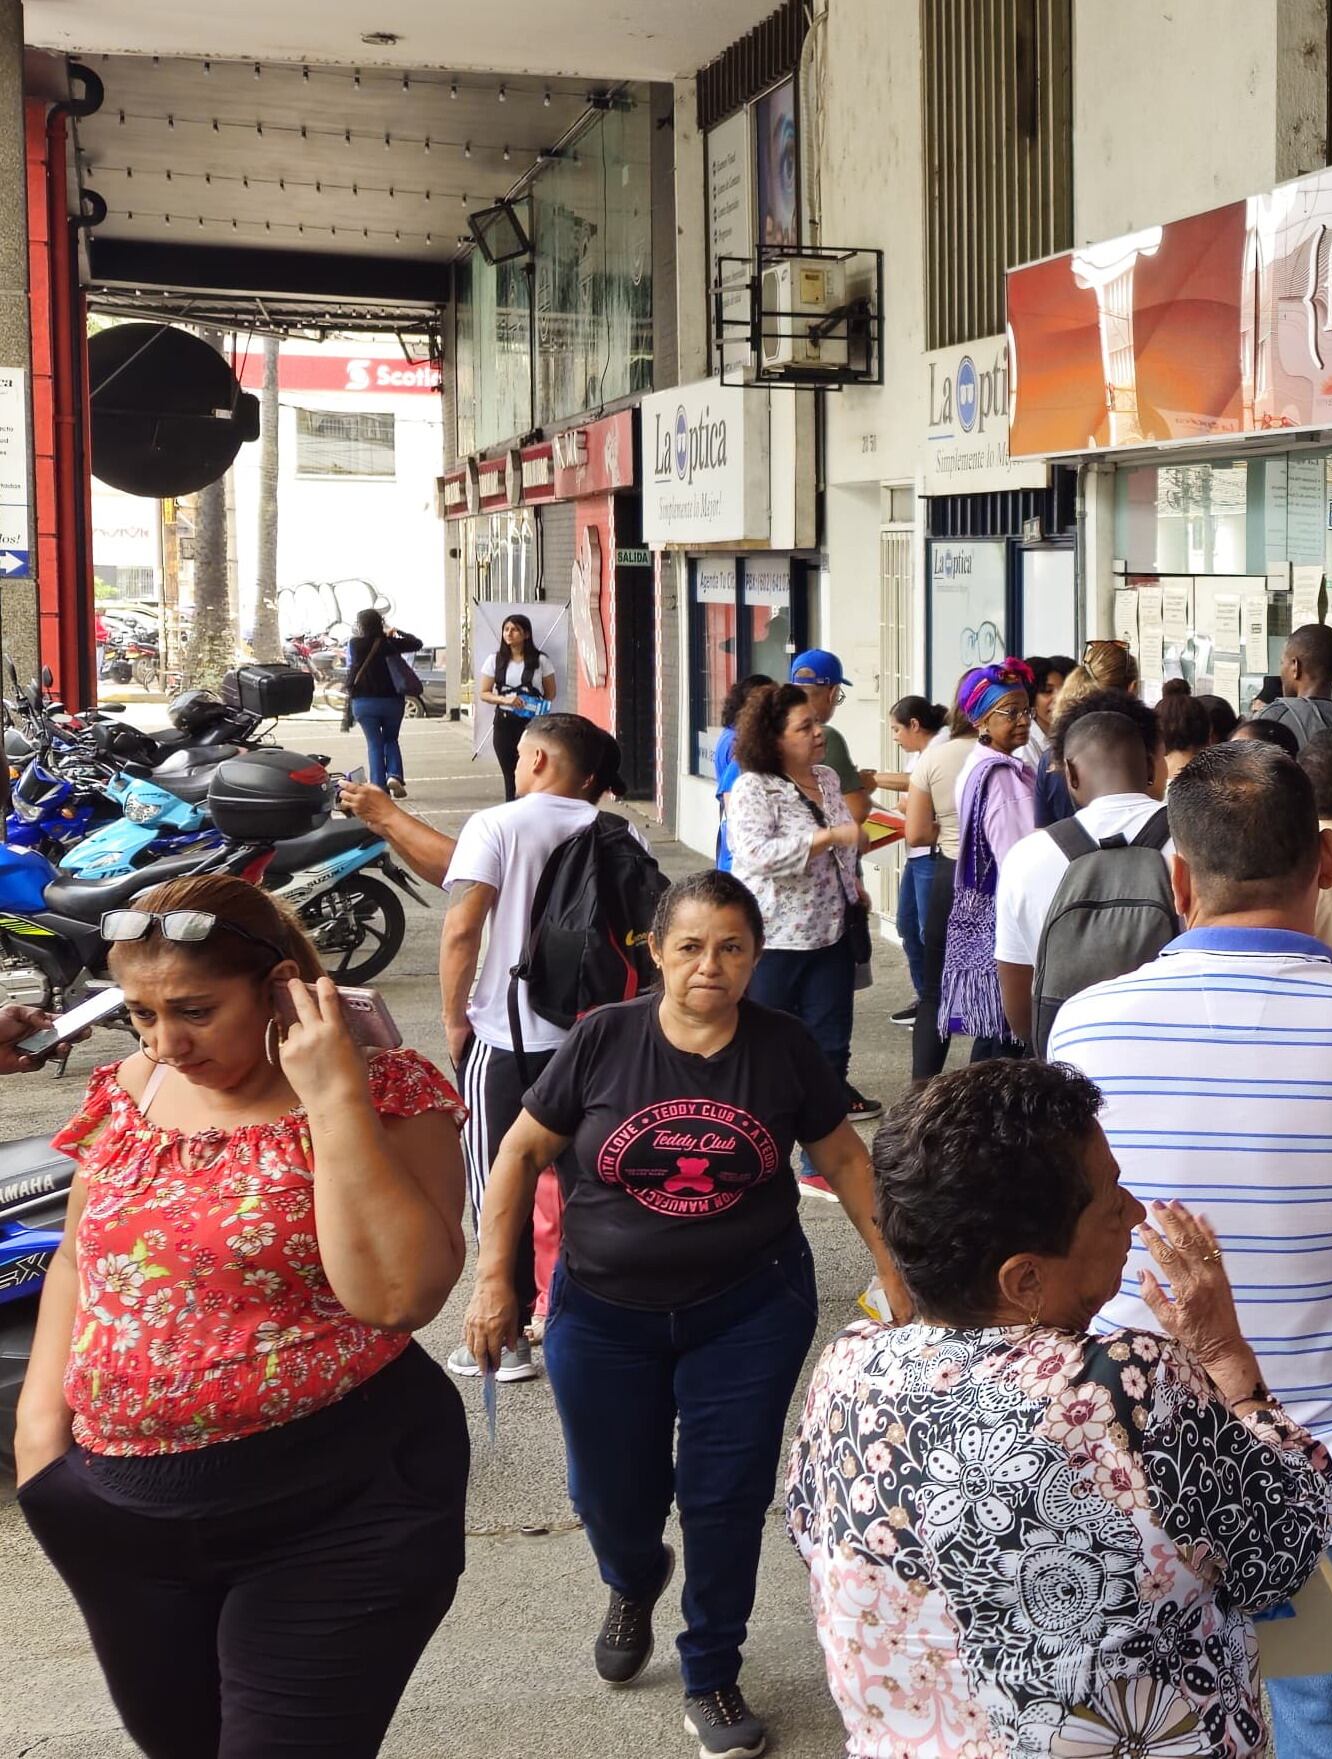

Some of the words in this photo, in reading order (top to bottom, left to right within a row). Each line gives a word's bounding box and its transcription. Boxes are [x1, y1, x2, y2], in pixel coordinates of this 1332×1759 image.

[929, 362, 953, 427] La
[655, 413, 671, 475] La
[936, 447, 984, 480] Simplemente
[986, 444, 995, 468] lo
[659, 495, 693, 525] Simplemente
[617, 551, 648, 563] SALIDA
[934, 549, 944, 574] La
[700, 571, 719, 593] Agenda
[719, 572, 726, 589] Tu
[306, 866, 345, 887] SUZUKI
[652, 1103, 697, 1121] TEDDY
[702, 1104, 736, 1123] CLUB
[612, 1124, 639, 1152] LOVE
[652, 1129, 699, 1151] Teddy
[699, 1132, 737, 1151] Club
